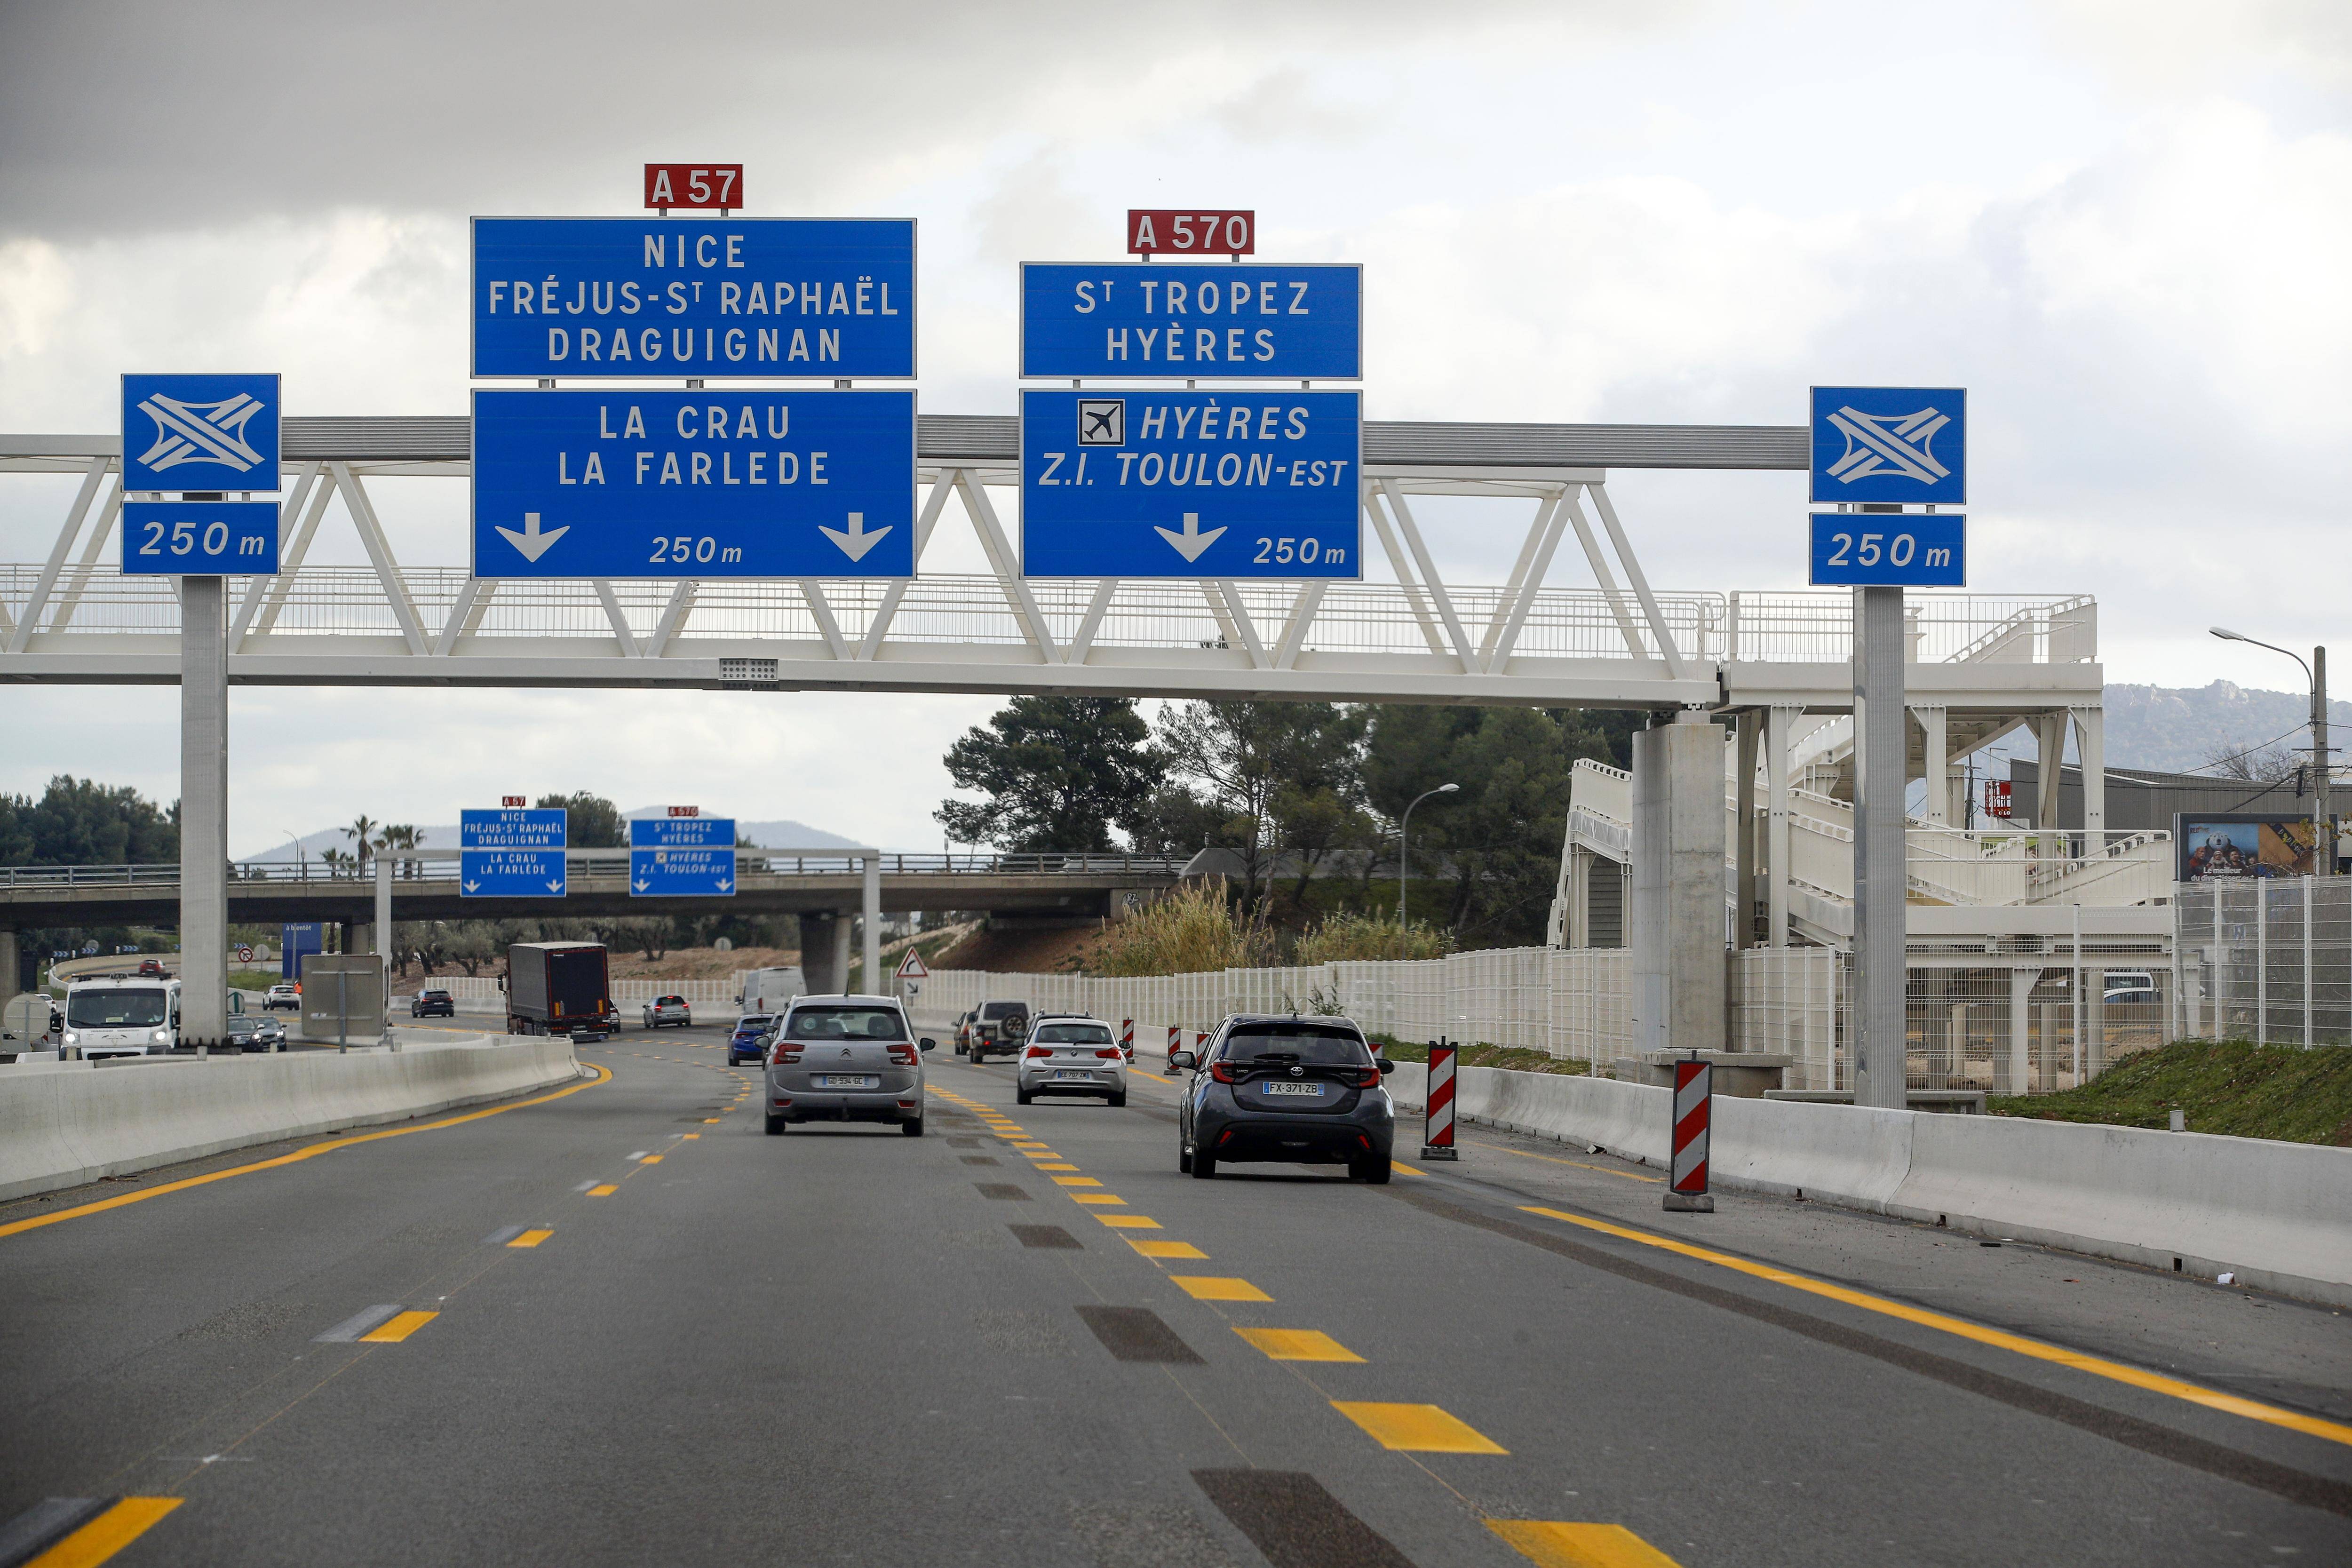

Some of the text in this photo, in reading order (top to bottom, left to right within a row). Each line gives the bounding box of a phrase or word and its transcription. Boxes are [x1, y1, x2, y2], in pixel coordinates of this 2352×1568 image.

[652, 170, 736, 203] A 57
[1135, 215, 1248, 250] A 570
[644, 235, 745, 268] NICE
[721, 276, 898, 315] RAPHAËL
[1141, 281, 1309, 315] TROPEZ
[549, 328, 839, 362] DRAGUIGNAN
[1107, 322, 1275, 361] HYÈRES
[600, 406, 788, 439] LA CRAU
[1140, 398, 1309, 440] HYÈRES
[560, 452, 828, 485] LA FARLEDE
[1039, 453, 1348, 486] Z.I. TOULON-EST
[139, 522, 264, 555] 250 m
[649, 537, 742, 563] 250 m
[1253, 537, 1344, 564] 250 m
[1828, 533, 1950, 566] 250 m
[501, 812, 526, 821] NICE
[519, 822, 562, 833] RAPHAËL
[670, 822, 712, 832] TROPEZ
[478, 835, 548, 844] DRAGUIGNAN
[481, 864, 493, 874] LA
[491, 853, 537, 863] LA CRAU
[1270, 1083, 1317, 1093] FX-371-ZB
